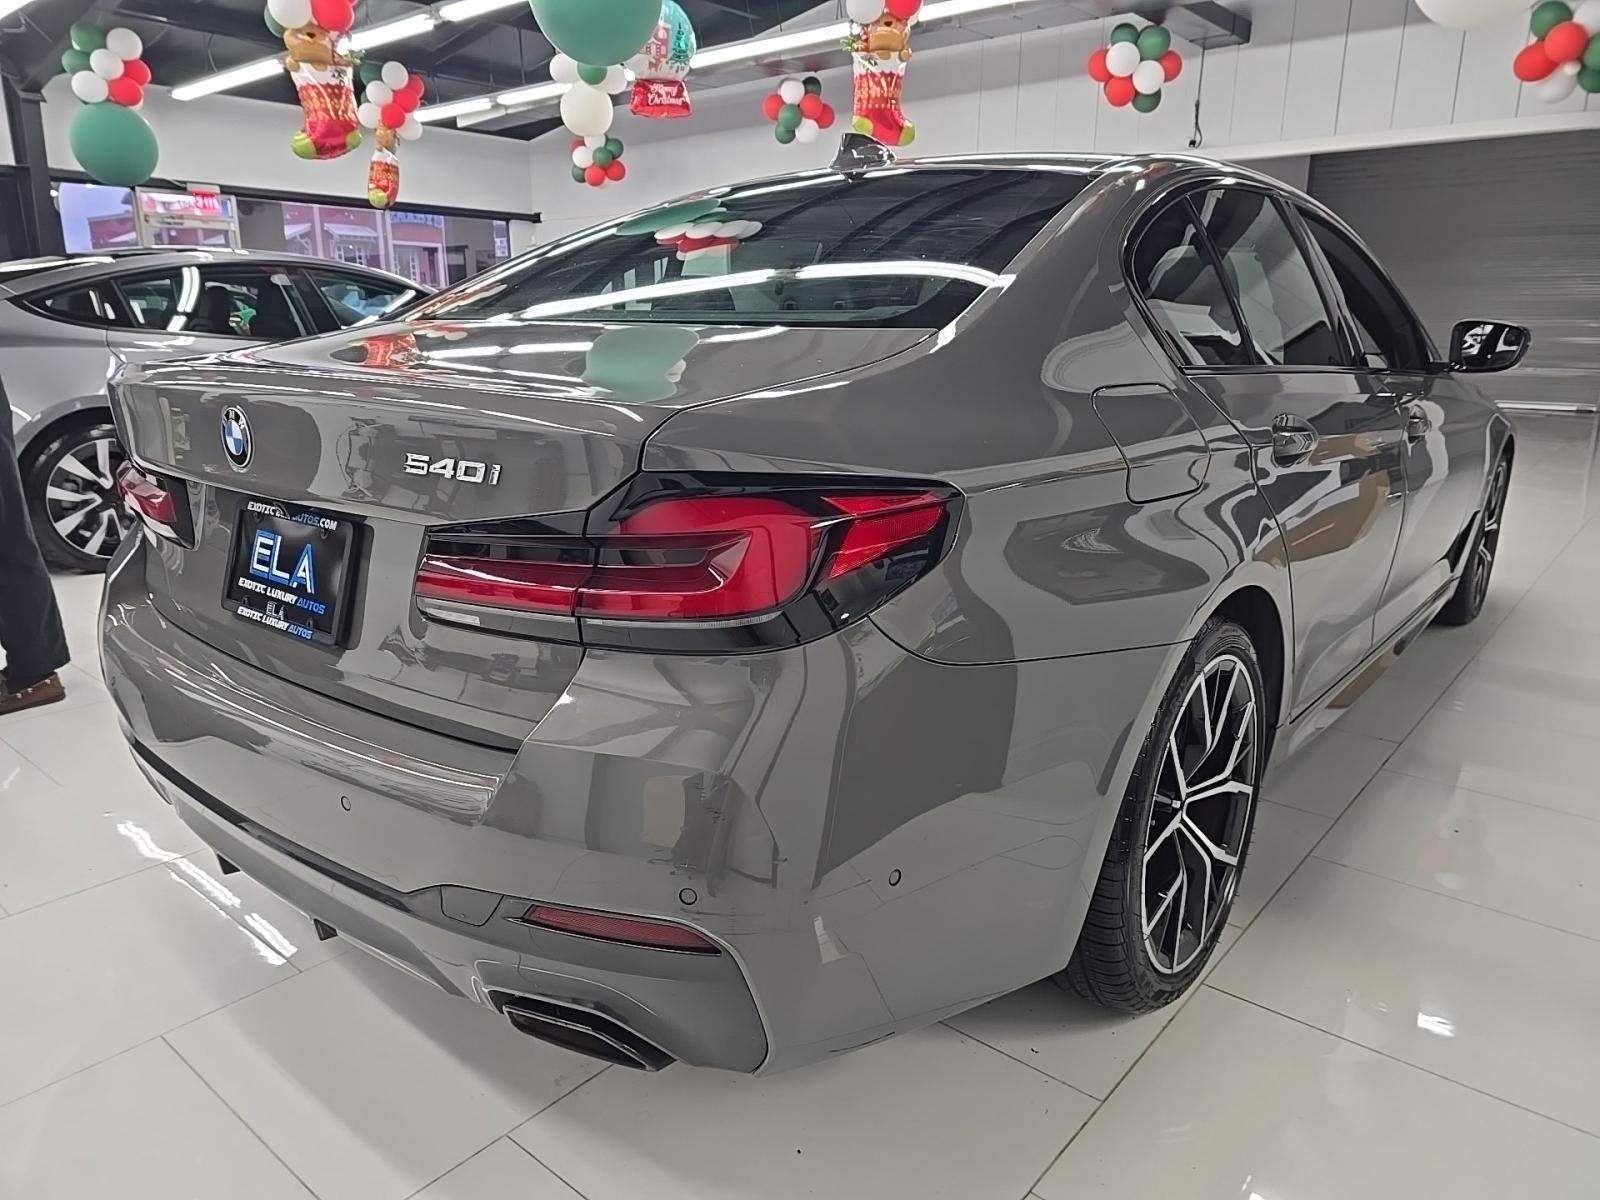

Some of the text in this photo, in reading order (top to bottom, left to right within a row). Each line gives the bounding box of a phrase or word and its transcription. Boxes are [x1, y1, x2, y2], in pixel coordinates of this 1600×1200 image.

[403, 452, 501, 485] 540i
[250, 529, 315, 594] ELA
[238, 577, 326, 615] EXOTIC LUXURY AUTOS
[265, 601, 285, 620] ELA
[237, 606, 313, 640] EXOTIC LUXURY AUTOS
